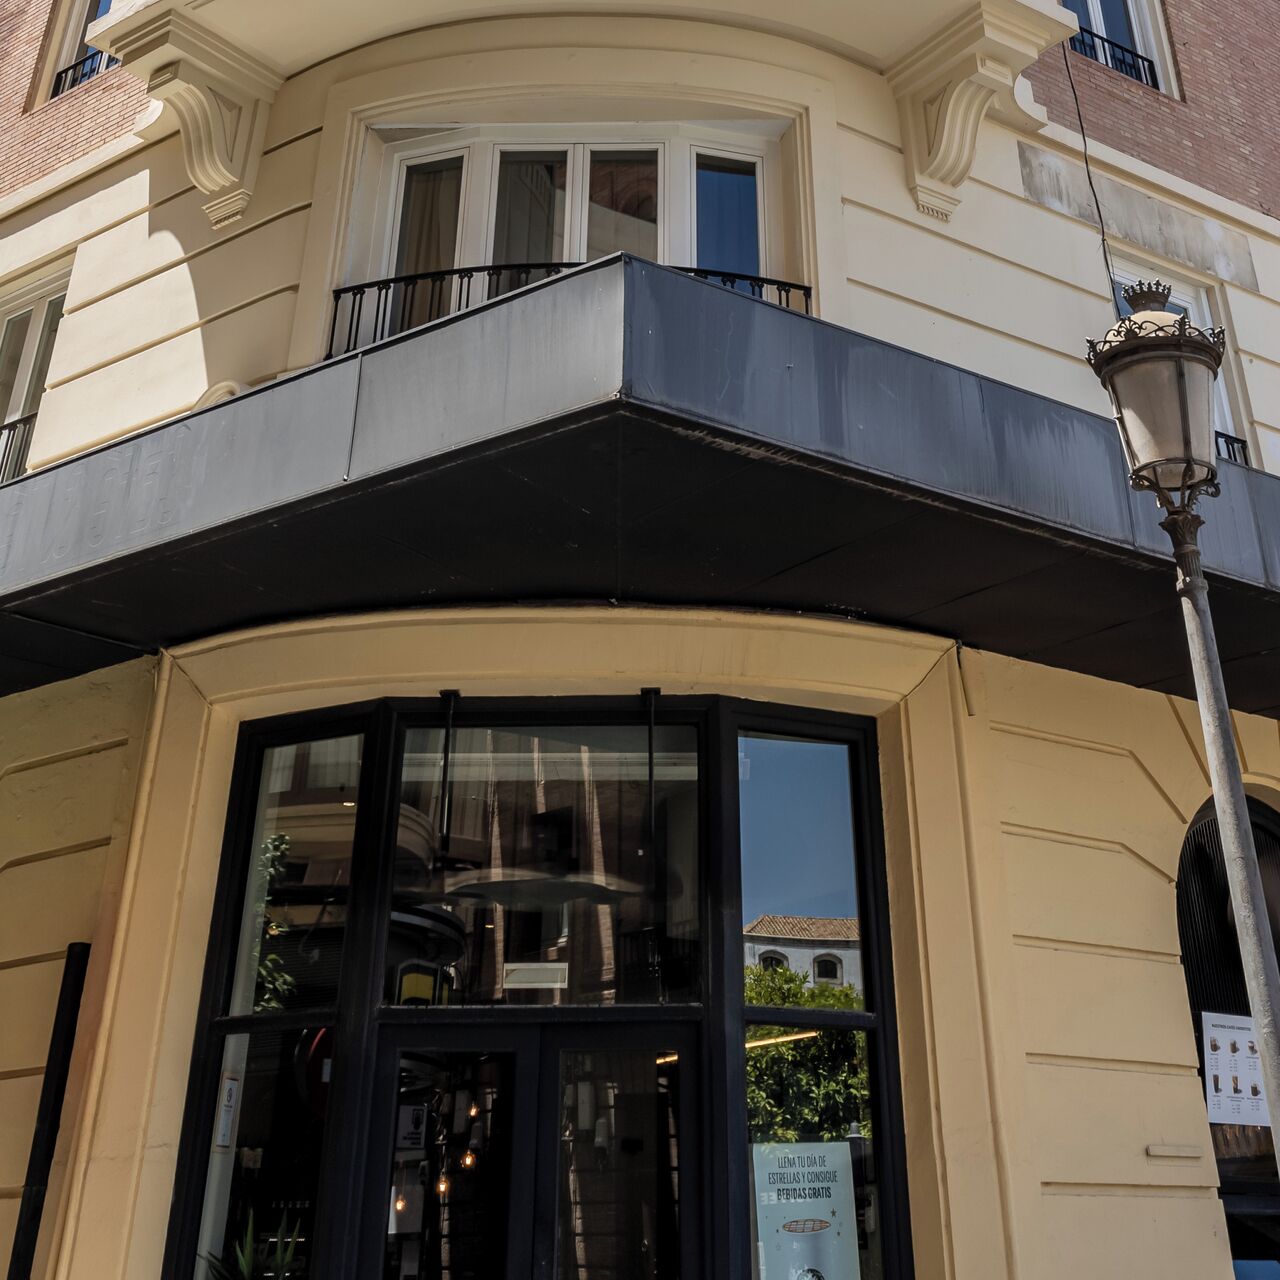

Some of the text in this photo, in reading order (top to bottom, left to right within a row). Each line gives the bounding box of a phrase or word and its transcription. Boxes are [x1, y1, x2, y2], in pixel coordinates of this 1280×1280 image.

[777, 1153, 827, 1169] LLENA TU DÍA DE
[768, 1170, 838, 1185] ESTRELLAS Y CONSIGUE
[777, 1187, 808, 1200] BEBIDAS
[807, 1186, 832, 1200] GRATIS
